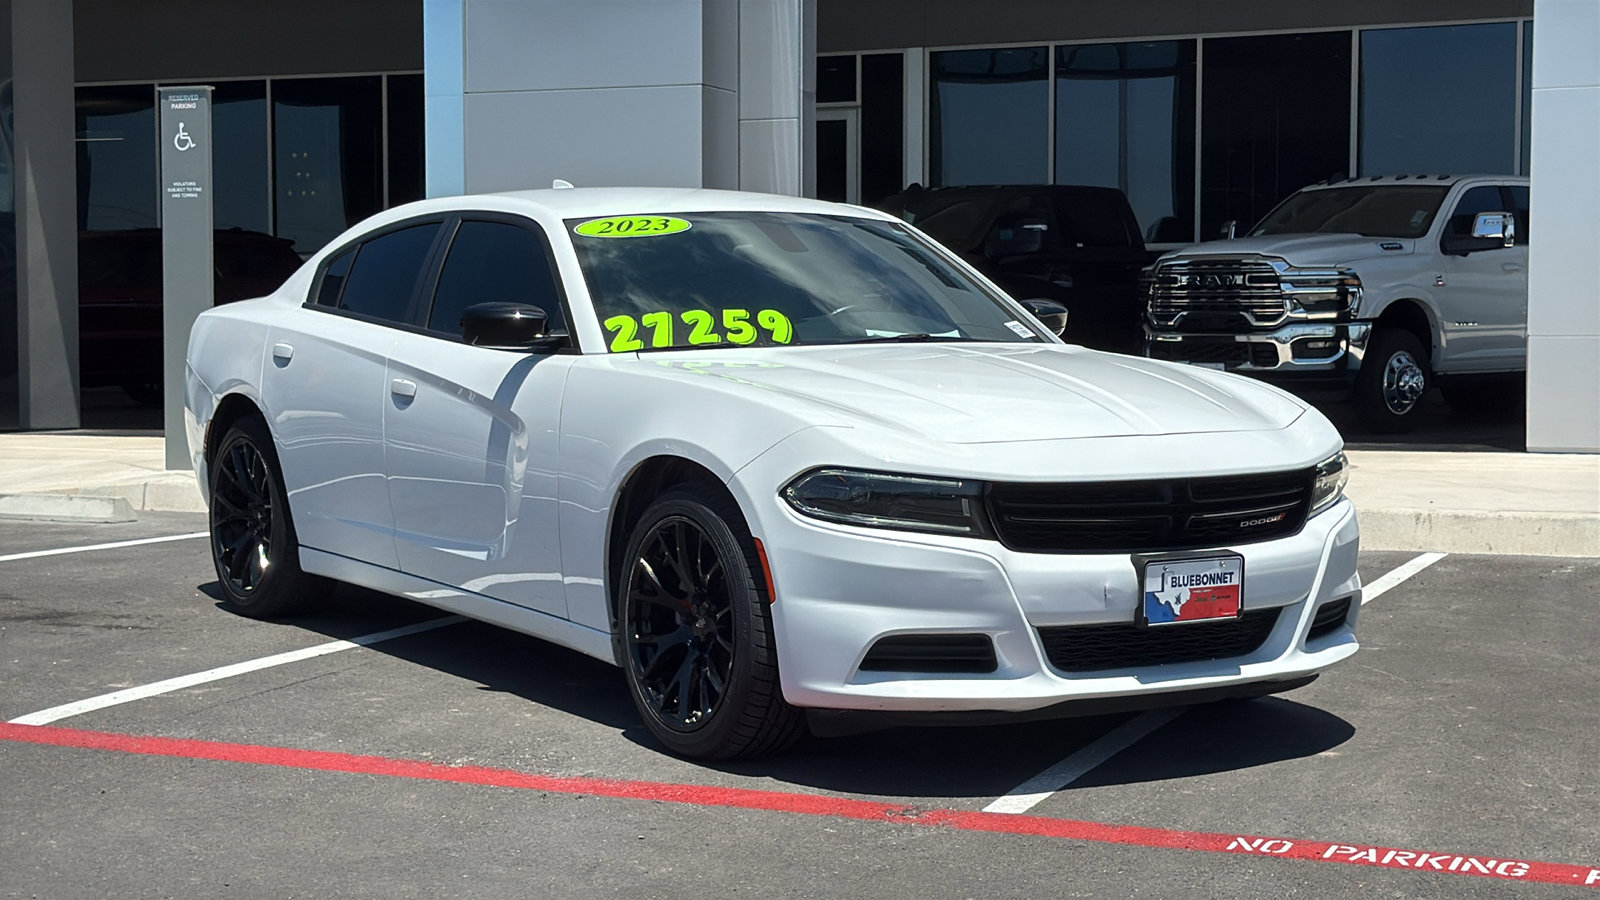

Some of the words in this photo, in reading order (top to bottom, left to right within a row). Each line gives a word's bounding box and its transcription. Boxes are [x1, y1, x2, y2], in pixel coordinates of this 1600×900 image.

[598, 219, 670, 234] 2023
[1181, 275, 1243, 285] RAM
[604, 309, 793, 352] 27259
[1240, 515, 1281, 527] DODGE
[1171, 572, 1234, 588] BLUEBONNET
[1226, 837, 1294, 854] NO
[1322, 845, 1530, 877] PARKING
